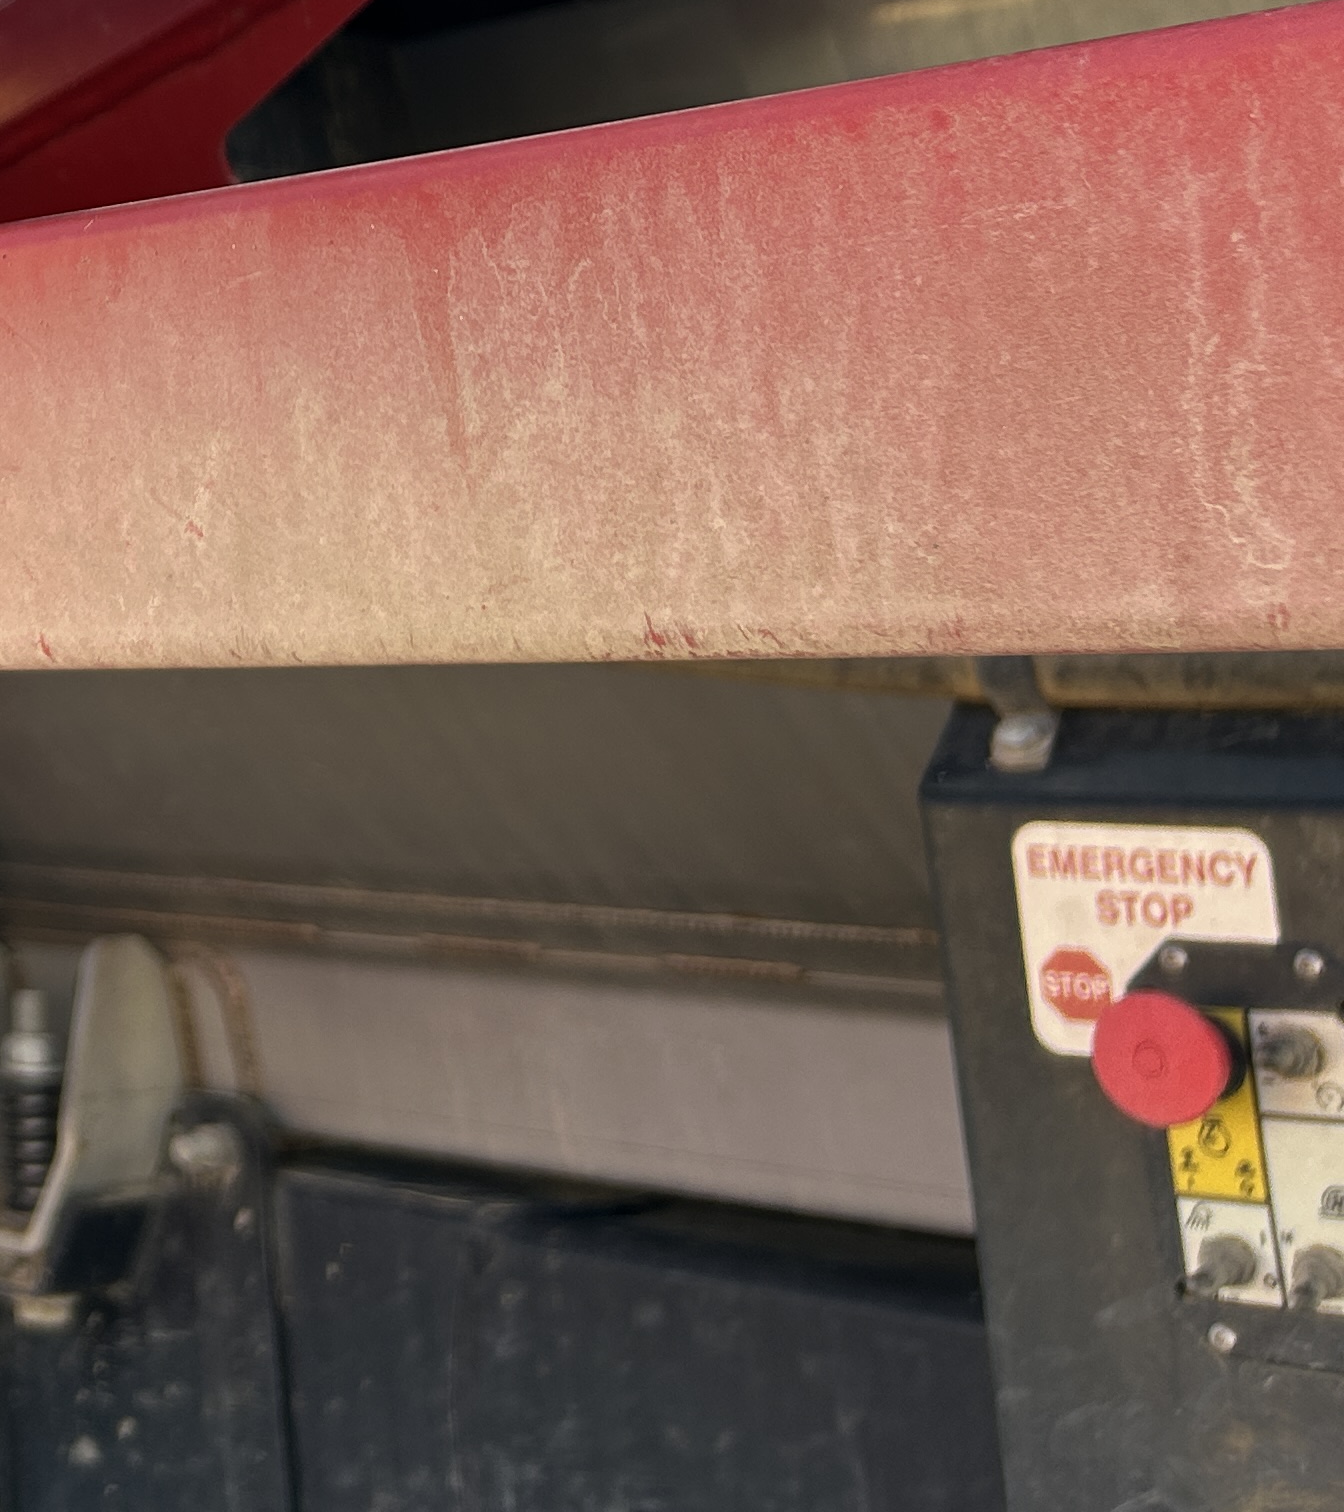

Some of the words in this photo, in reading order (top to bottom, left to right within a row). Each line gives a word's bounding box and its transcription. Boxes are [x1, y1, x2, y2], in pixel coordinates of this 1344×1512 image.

[1026, 842, 1258, 888] EMERGENCY
[1095, 890, 1194, 929] STOP
[1045, 972, 1109, 1002] STOP
